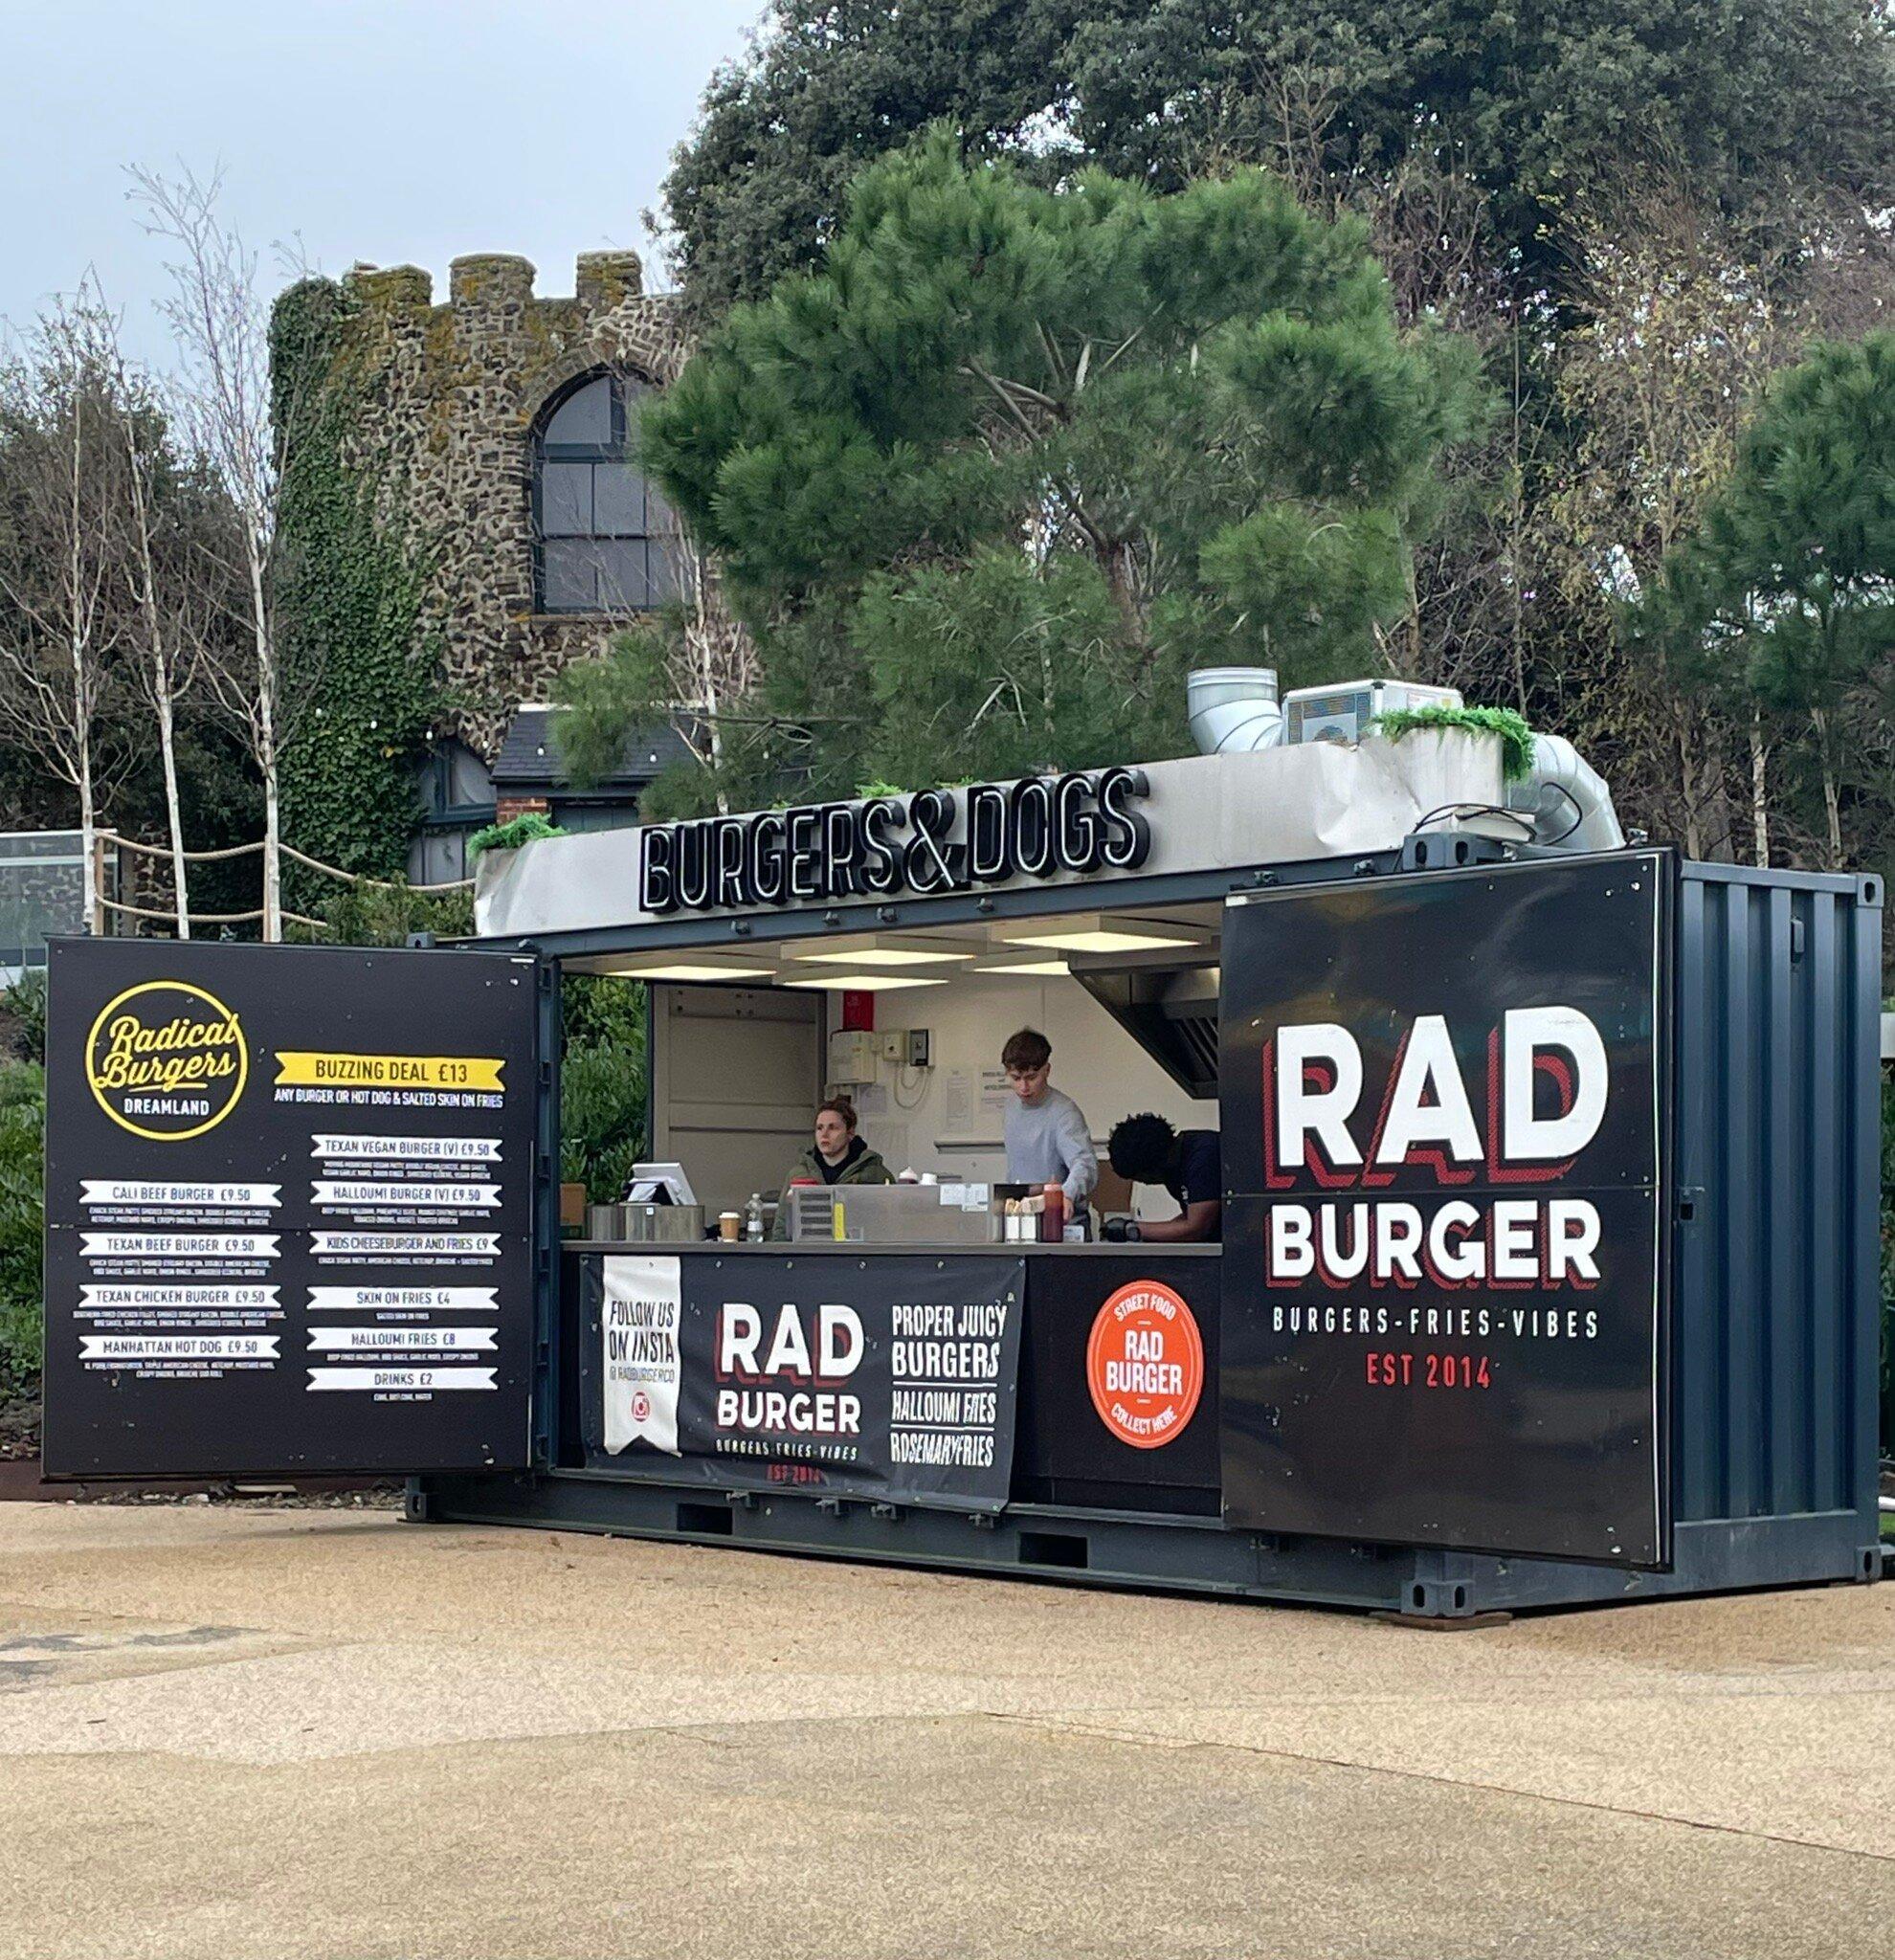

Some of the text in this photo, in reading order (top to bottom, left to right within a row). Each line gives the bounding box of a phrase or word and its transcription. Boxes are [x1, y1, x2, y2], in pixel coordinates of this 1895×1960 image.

[109, 1013, 239, 1055] Radical
[95, 1052, 236, 1093] Burgers
[315, 1059, 469, 1083] BUZZING DEAL £13
[274, 1088, 295, 1102] ANY
[296, 1089, 334, 1103] BURGER
[335, 1090, 349, 1103] OR
[351, 1090, 370, 1103] HOT
[371, 1091, 391, 1104] DOG
[392, 1091, 401, 1105] &
[402, 1092, 436, 1106] SALTED
[461, 1094, 476, 1107] ON
[477, 1094, 503, 1108] FRIES
[1273, 1006, 1609, 1171] RAD
[123, 1098, 211, 1116] DREAMLAND
[324, 1140, 490, 1156] TEXAN VEGAN BURGER (V) £9.50
[112, 1187, 251, 1201] CALI BEEF BURGER £9.50
[333, 1187, 480, 1202] HALLOUMI BURGER (V) £9.50
[107, 1238, 255, 1252] TEXAN BEEF BURGER £9.50
[326, 1236, 489, 1251] KIDS CHEESEBURGER AND FRIES £9
[1267, 1199, 1601, 1284] BURGER
[96, 1290, 265, 1303] TEXAN CHICKEN BURGER £9.50
[357, 1291, 450, 1304] SKIN ON FRIES £4
[1113, 1292, 1177, 1323] STREET FOOD
[609, 1300, 675, 1328] FOLLOW US
[892, 1304, 1008, 1338] PROPER JUICY
[103, 1341, 257, 1353] MANHATTAN HOT DOG £9.50
[351, 1333, 456, 1346] HALLOUMI FRIES £8
[609, 1330, 675, 1364] ON INSTA
[719, 1303, 864, 1377] RAD
[1125, 1329, 1164, 1362] RAD
[891, 1341, 1000, 1378] BURGERS
[1366, 1352, 1491, 1389] EST 2014
[374, 1373, 433, 1386] DRINKS £2
[1105, 1360, 1183, 1396] BURGER
[716, 1390, 860, 1435] BURGER
[891, 1391, 961, 1423] HALLOUMI
[1110, 1402, 1178, 1436] COLLECT HERE
[890, 1432, 994, 1468] ROSEMARY FRIES
